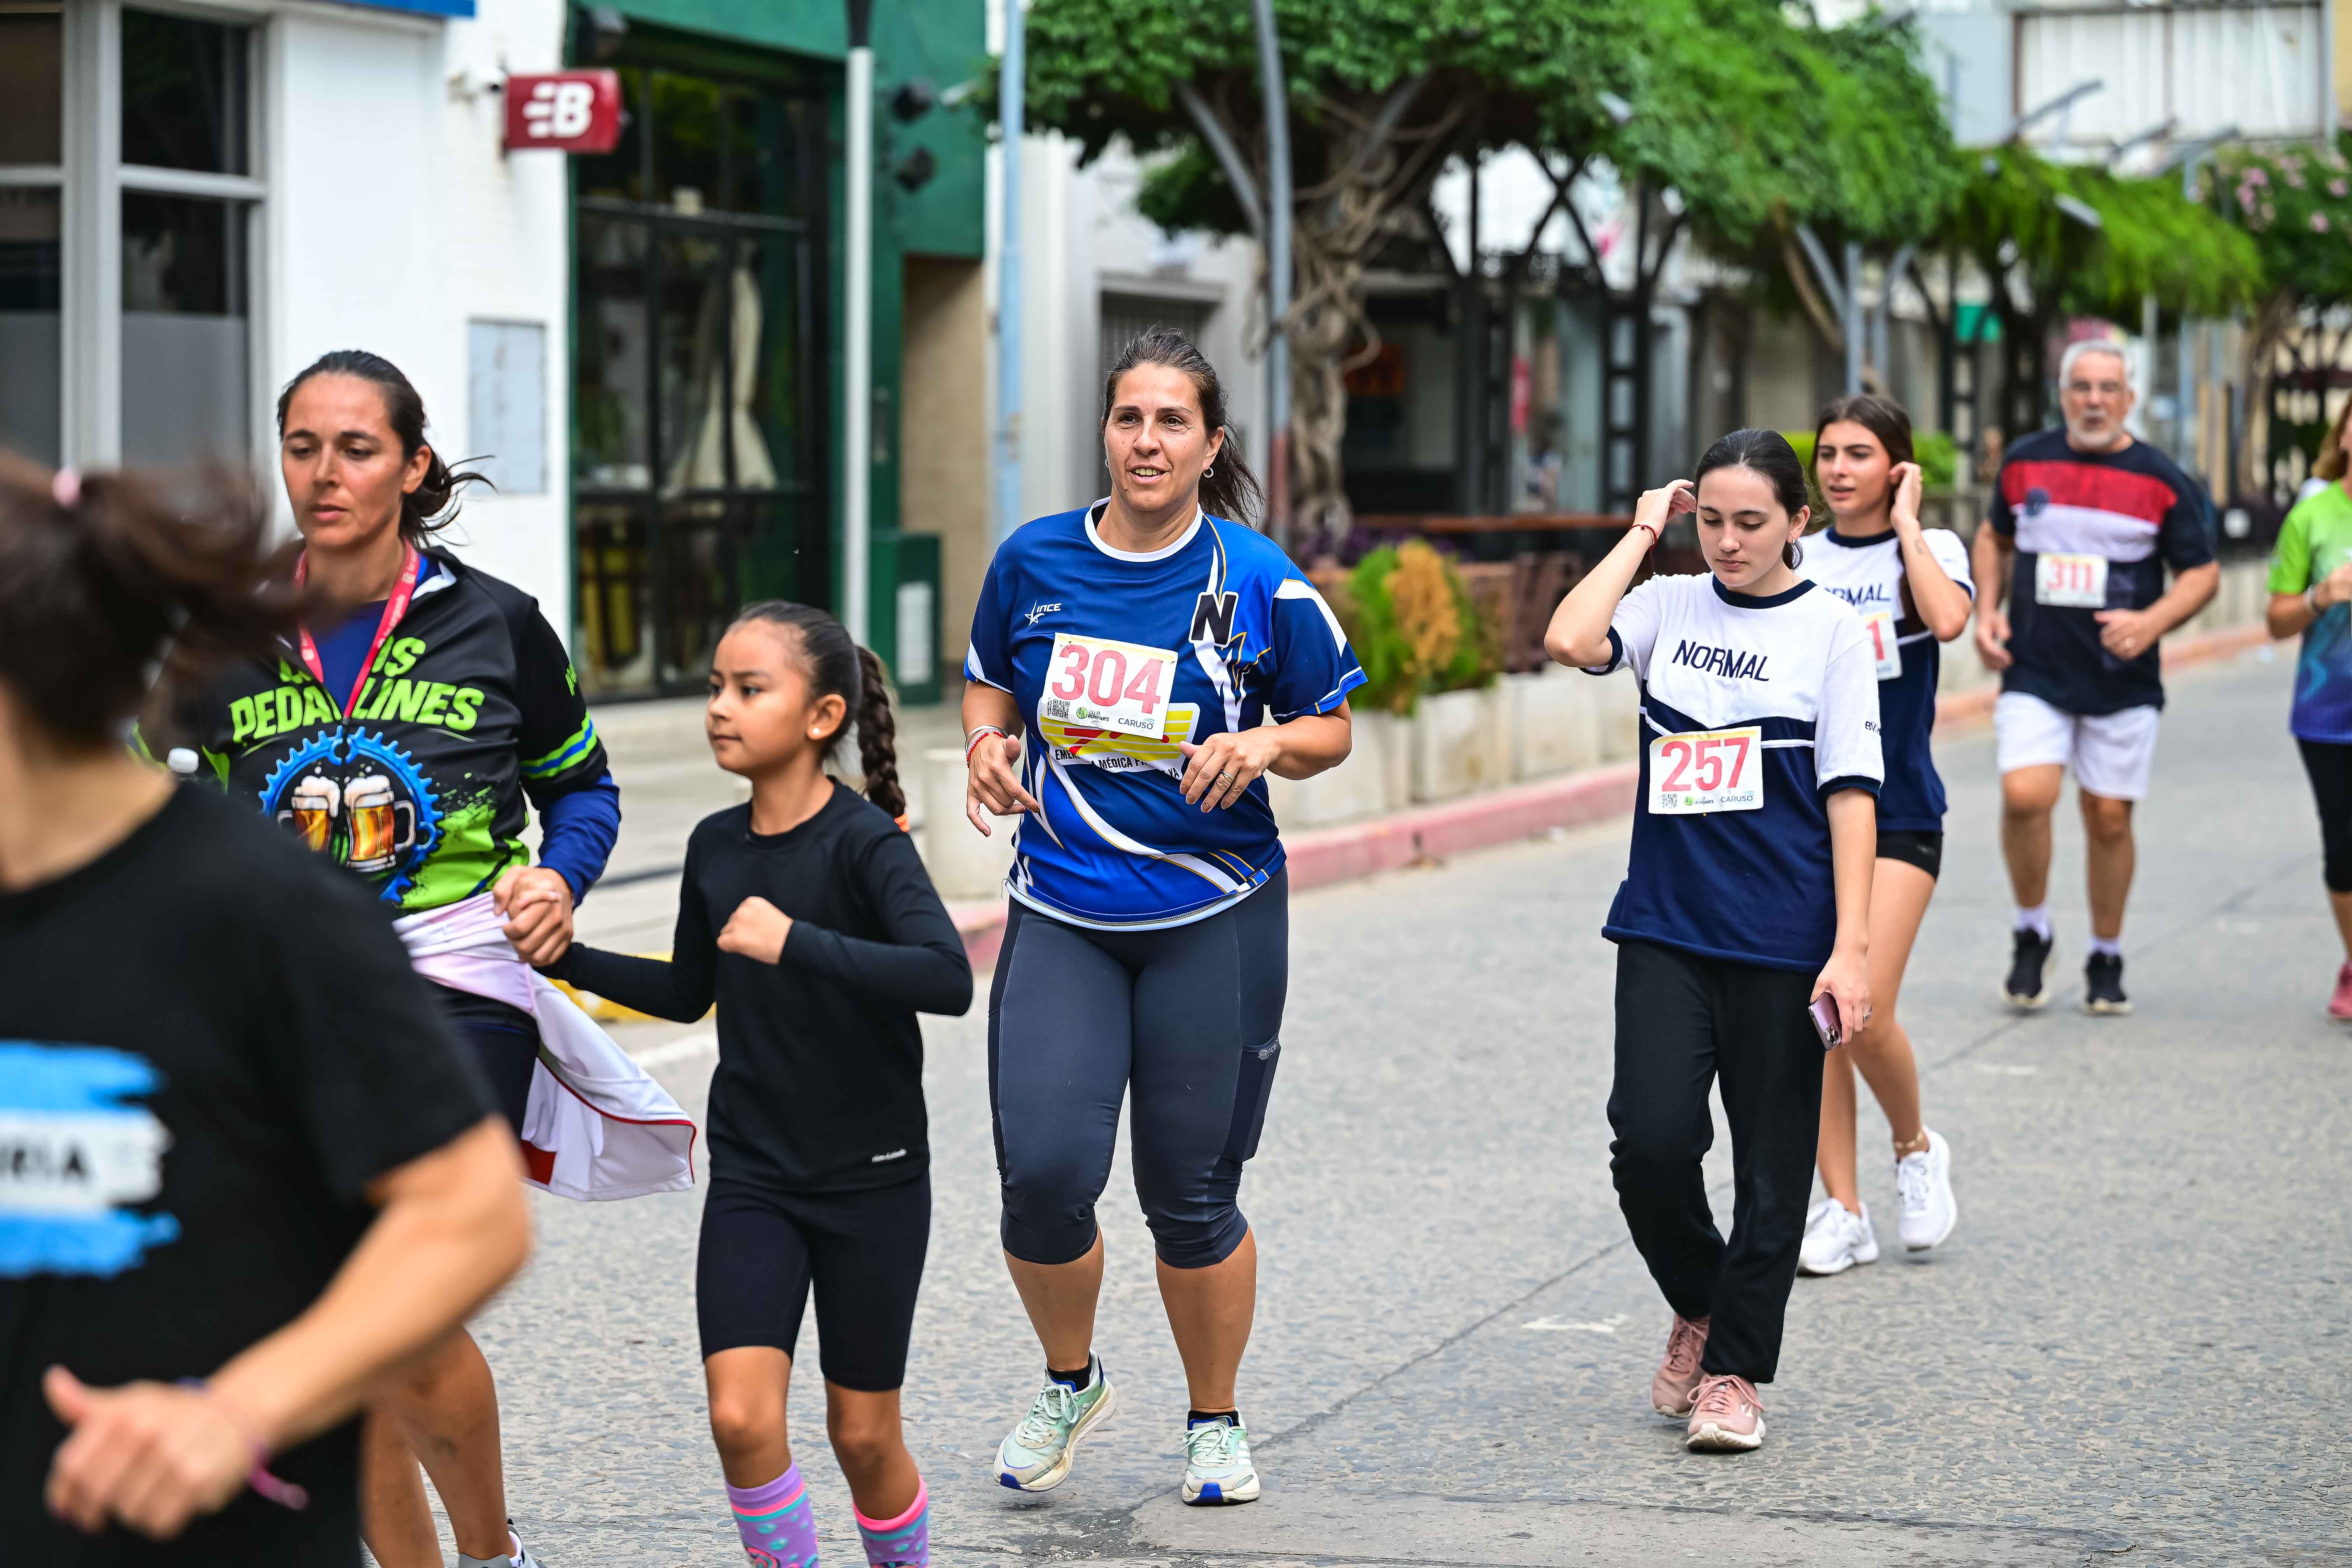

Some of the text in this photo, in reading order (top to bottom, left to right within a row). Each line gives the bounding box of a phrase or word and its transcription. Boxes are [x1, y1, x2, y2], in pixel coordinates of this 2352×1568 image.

[2047, 556, 2095, 594] 311
[1052, 644, 1162, 714] 304
[1672, 639, 1770, 682] NORMAL
[1118, 718, 1153, 730] CARUSO
[1099, 757, 1133, 770] MÉDICA
[1661, 737, 1750, 792] 257
